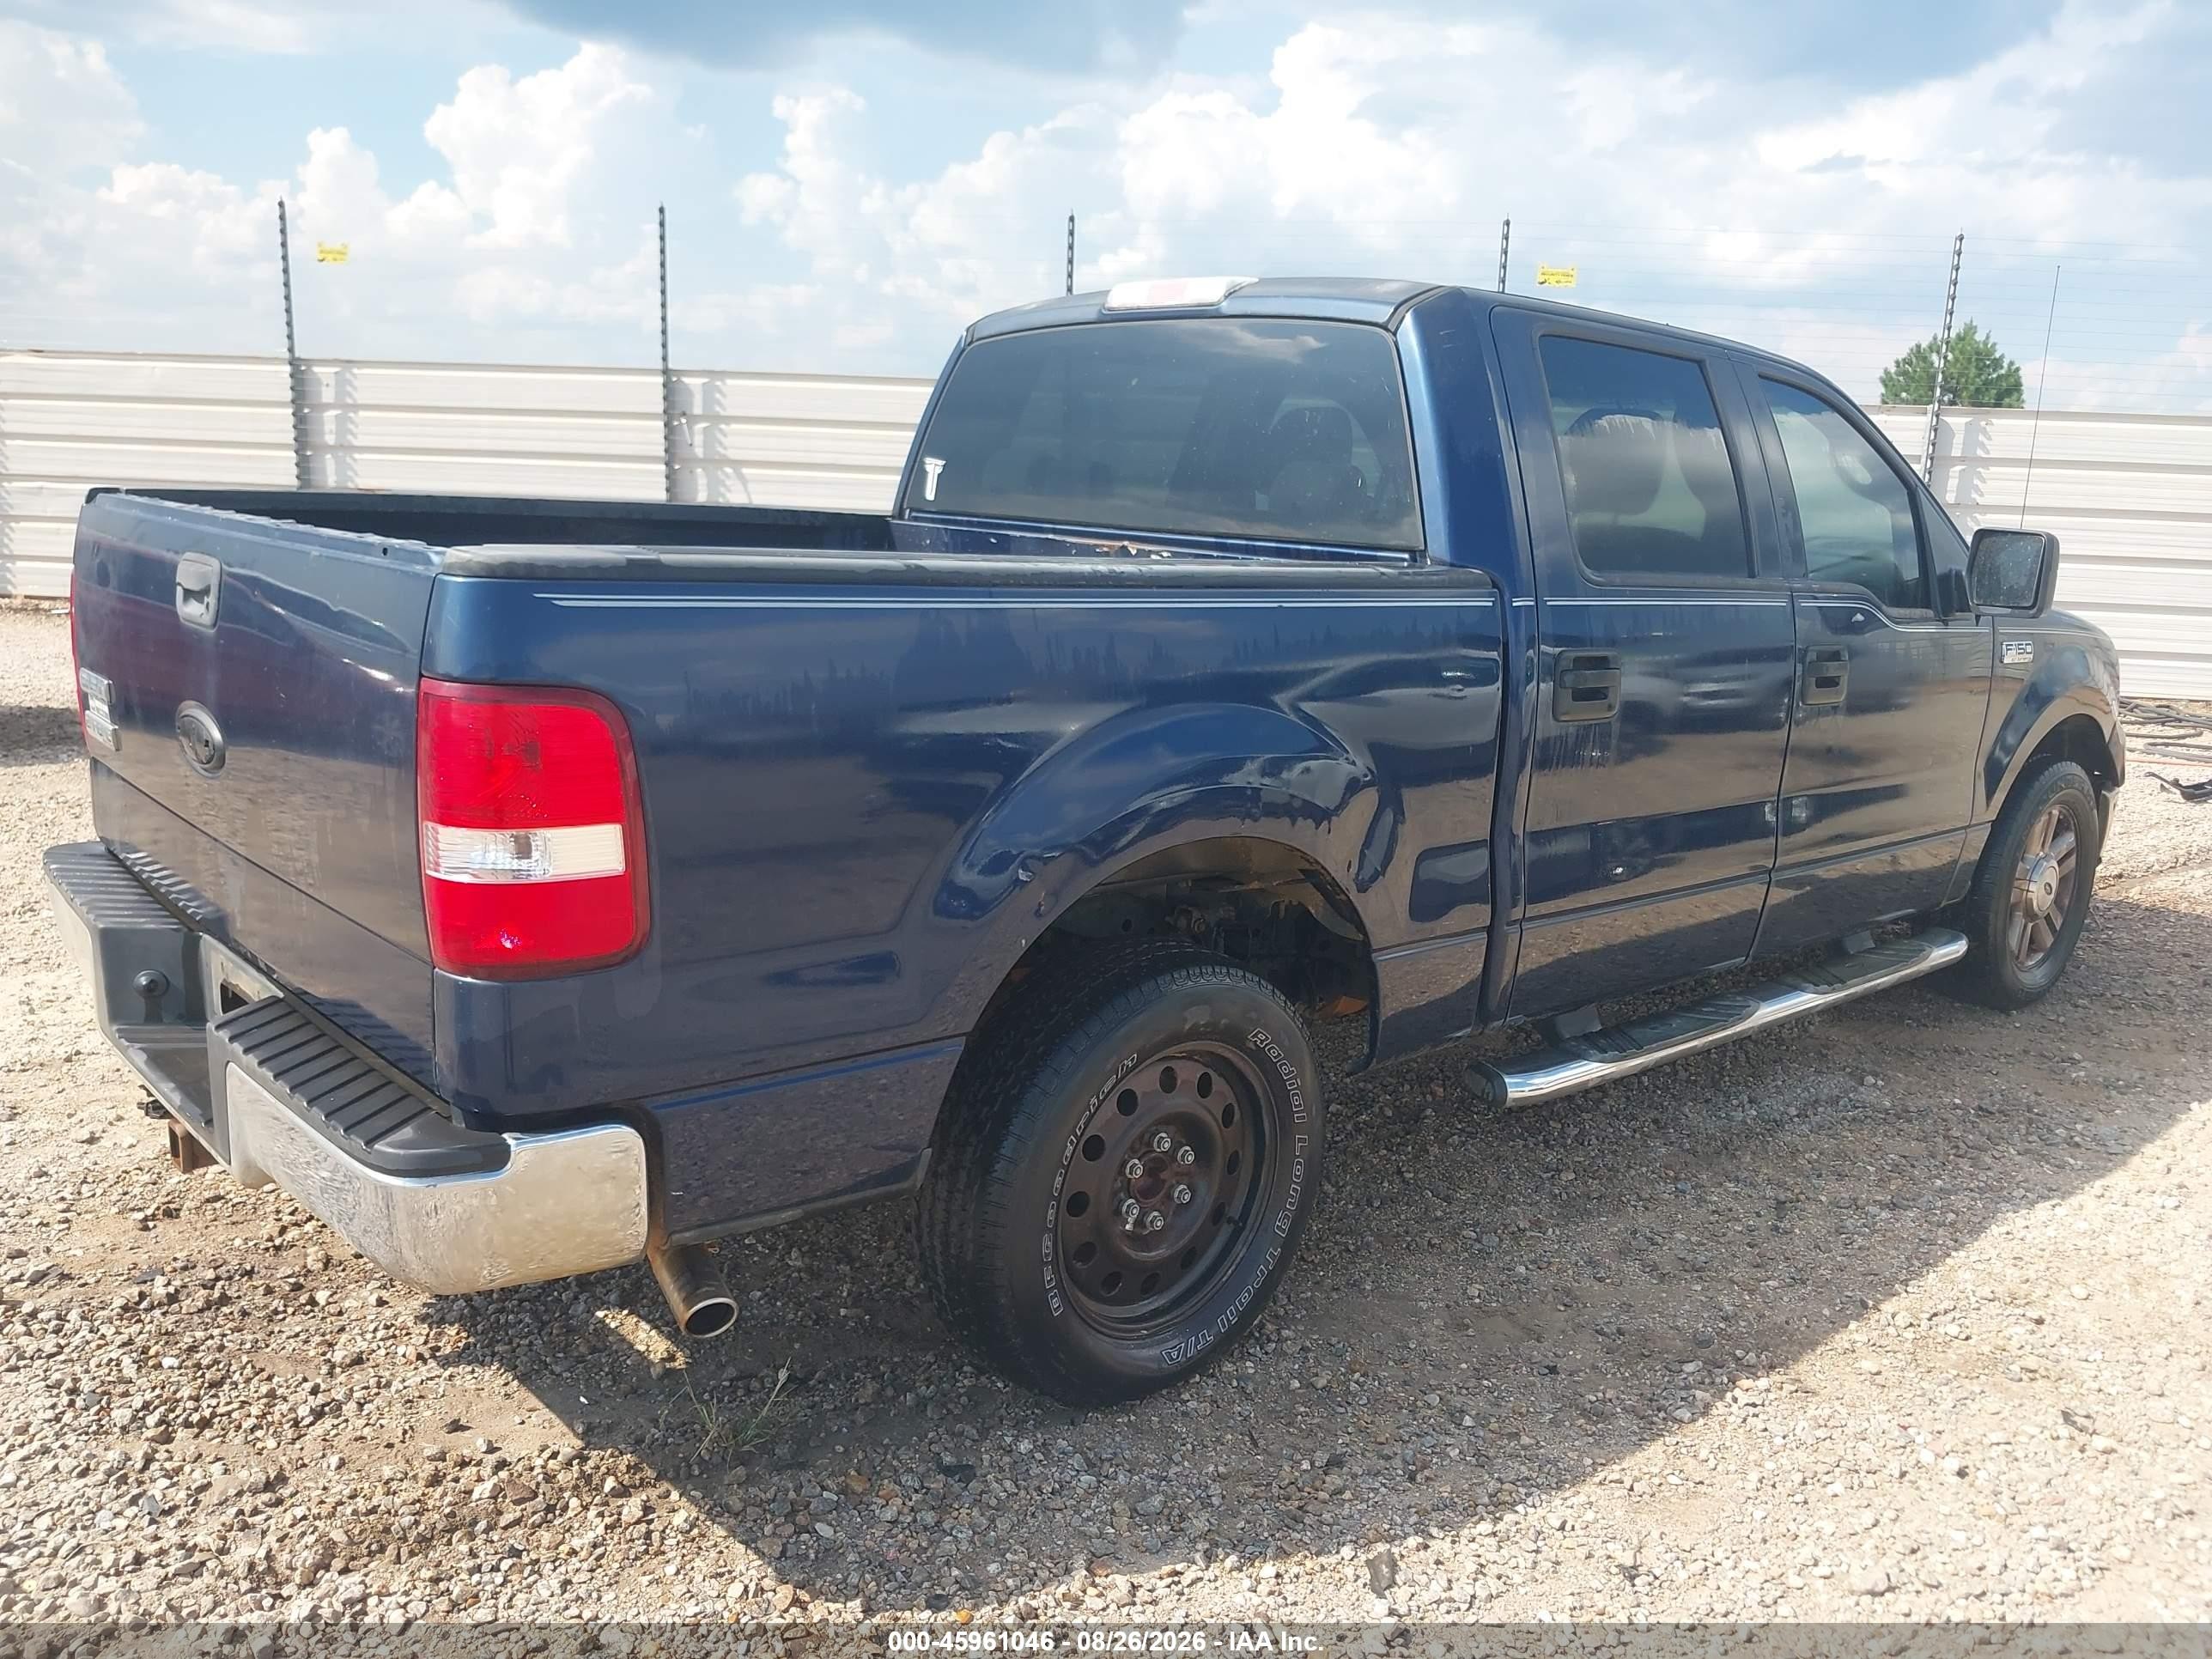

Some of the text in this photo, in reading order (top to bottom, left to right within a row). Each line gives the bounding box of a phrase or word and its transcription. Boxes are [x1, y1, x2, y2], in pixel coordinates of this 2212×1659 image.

[1042, 1053, 1137, 1316] BFGoodrich
[1160, 1027, 1309, 1367] Radial Long Trail T/A
